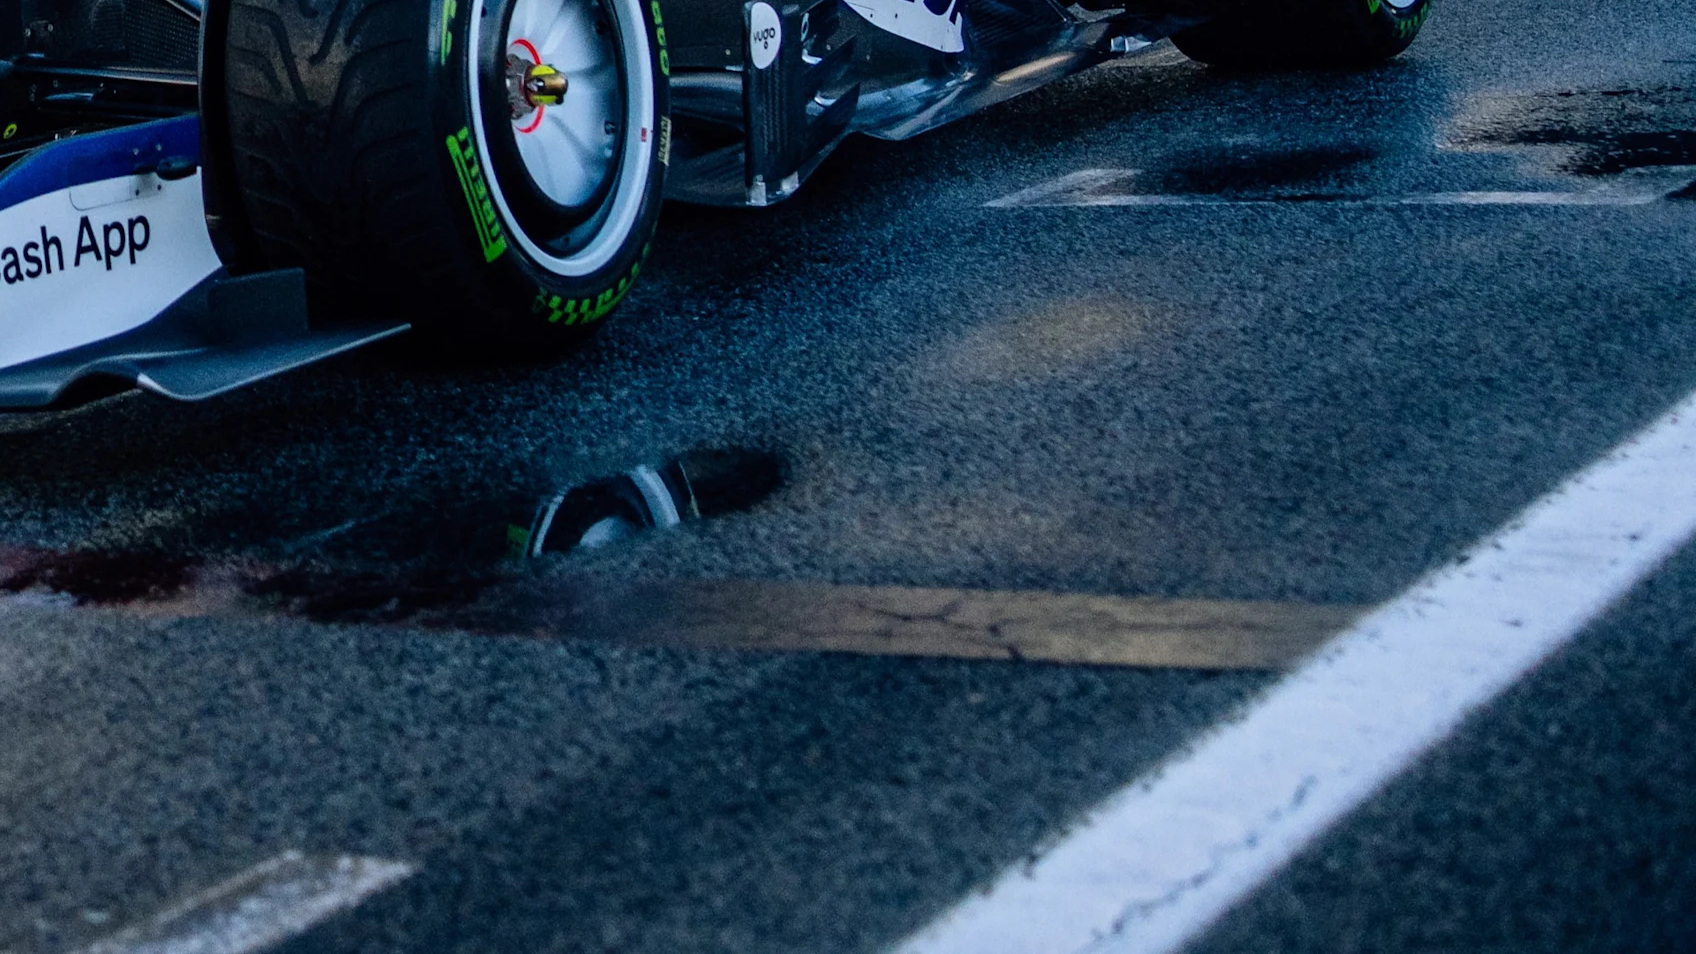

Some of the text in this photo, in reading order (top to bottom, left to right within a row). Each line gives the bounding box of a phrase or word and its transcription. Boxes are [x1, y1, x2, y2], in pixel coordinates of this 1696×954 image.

[753, 27, 776, 50] yugo
[446, 126, 508, 263] PIRELLI
[73, 214, 151, 271] App
